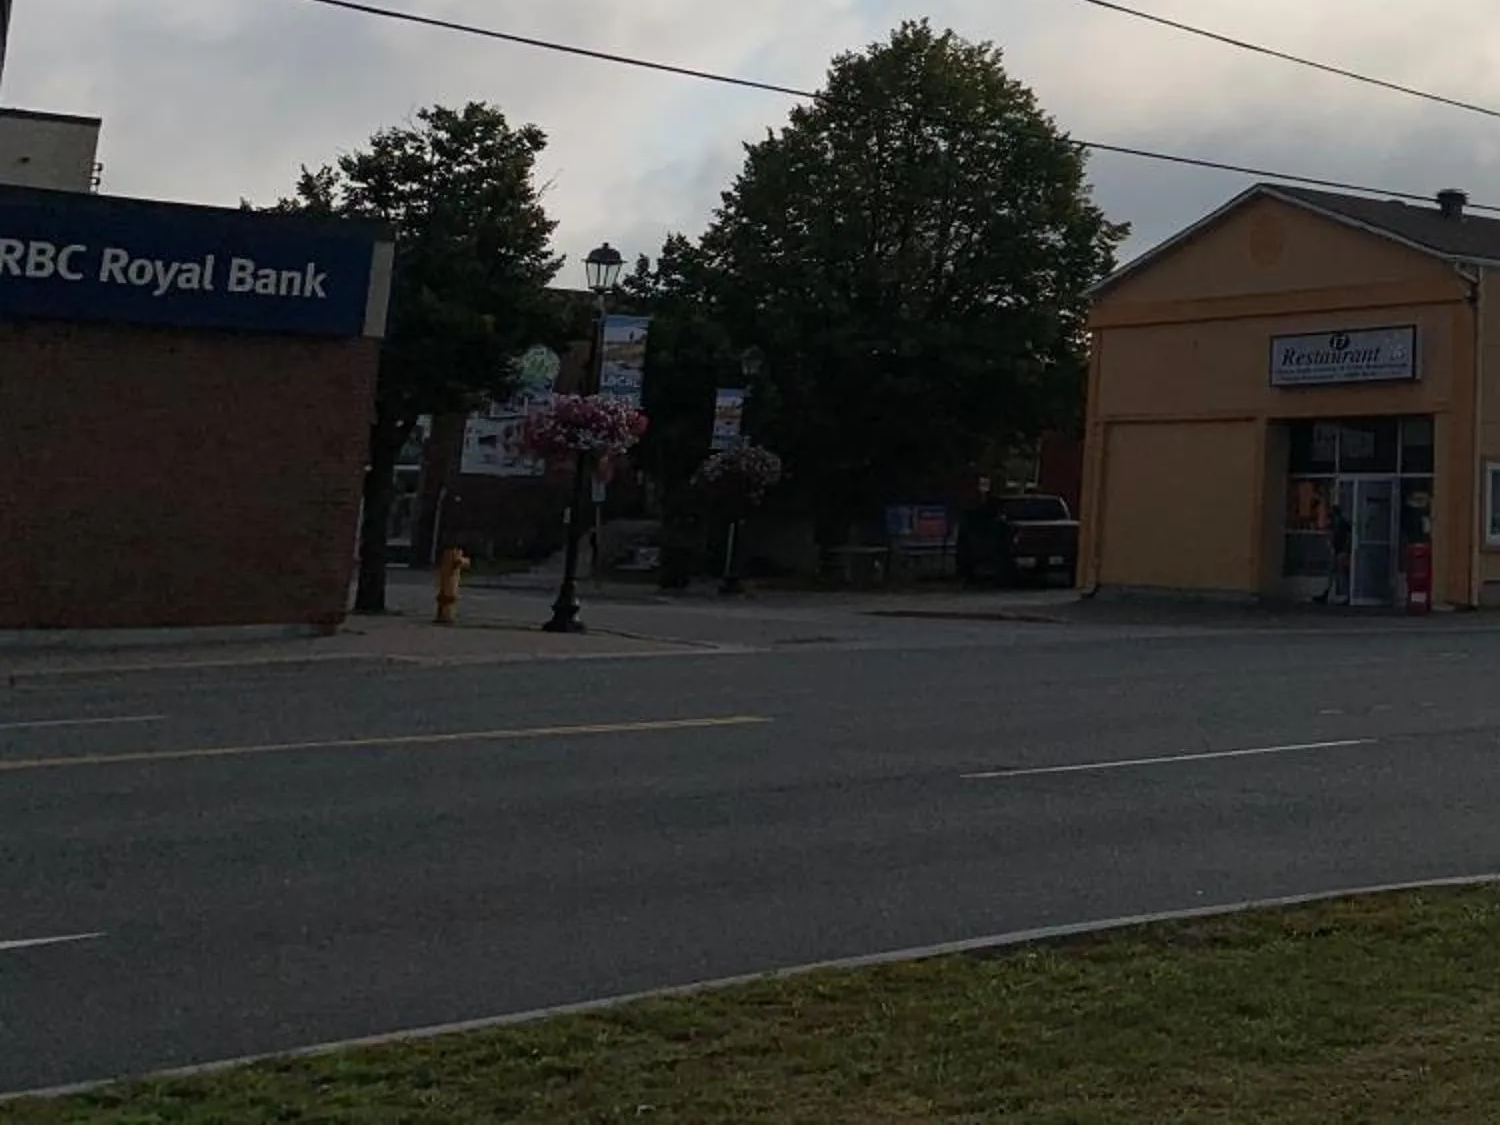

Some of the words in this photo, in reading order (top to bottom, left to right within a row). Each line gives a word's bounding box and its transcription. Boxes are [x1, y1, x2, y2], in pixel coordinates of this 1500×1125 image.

[0, 238, 87, 280] RBC
[99, 247, 214, 296] Royal
[227, 257, 328, 299] Bank
[1281, 346, 1380, 366] Restaurant
